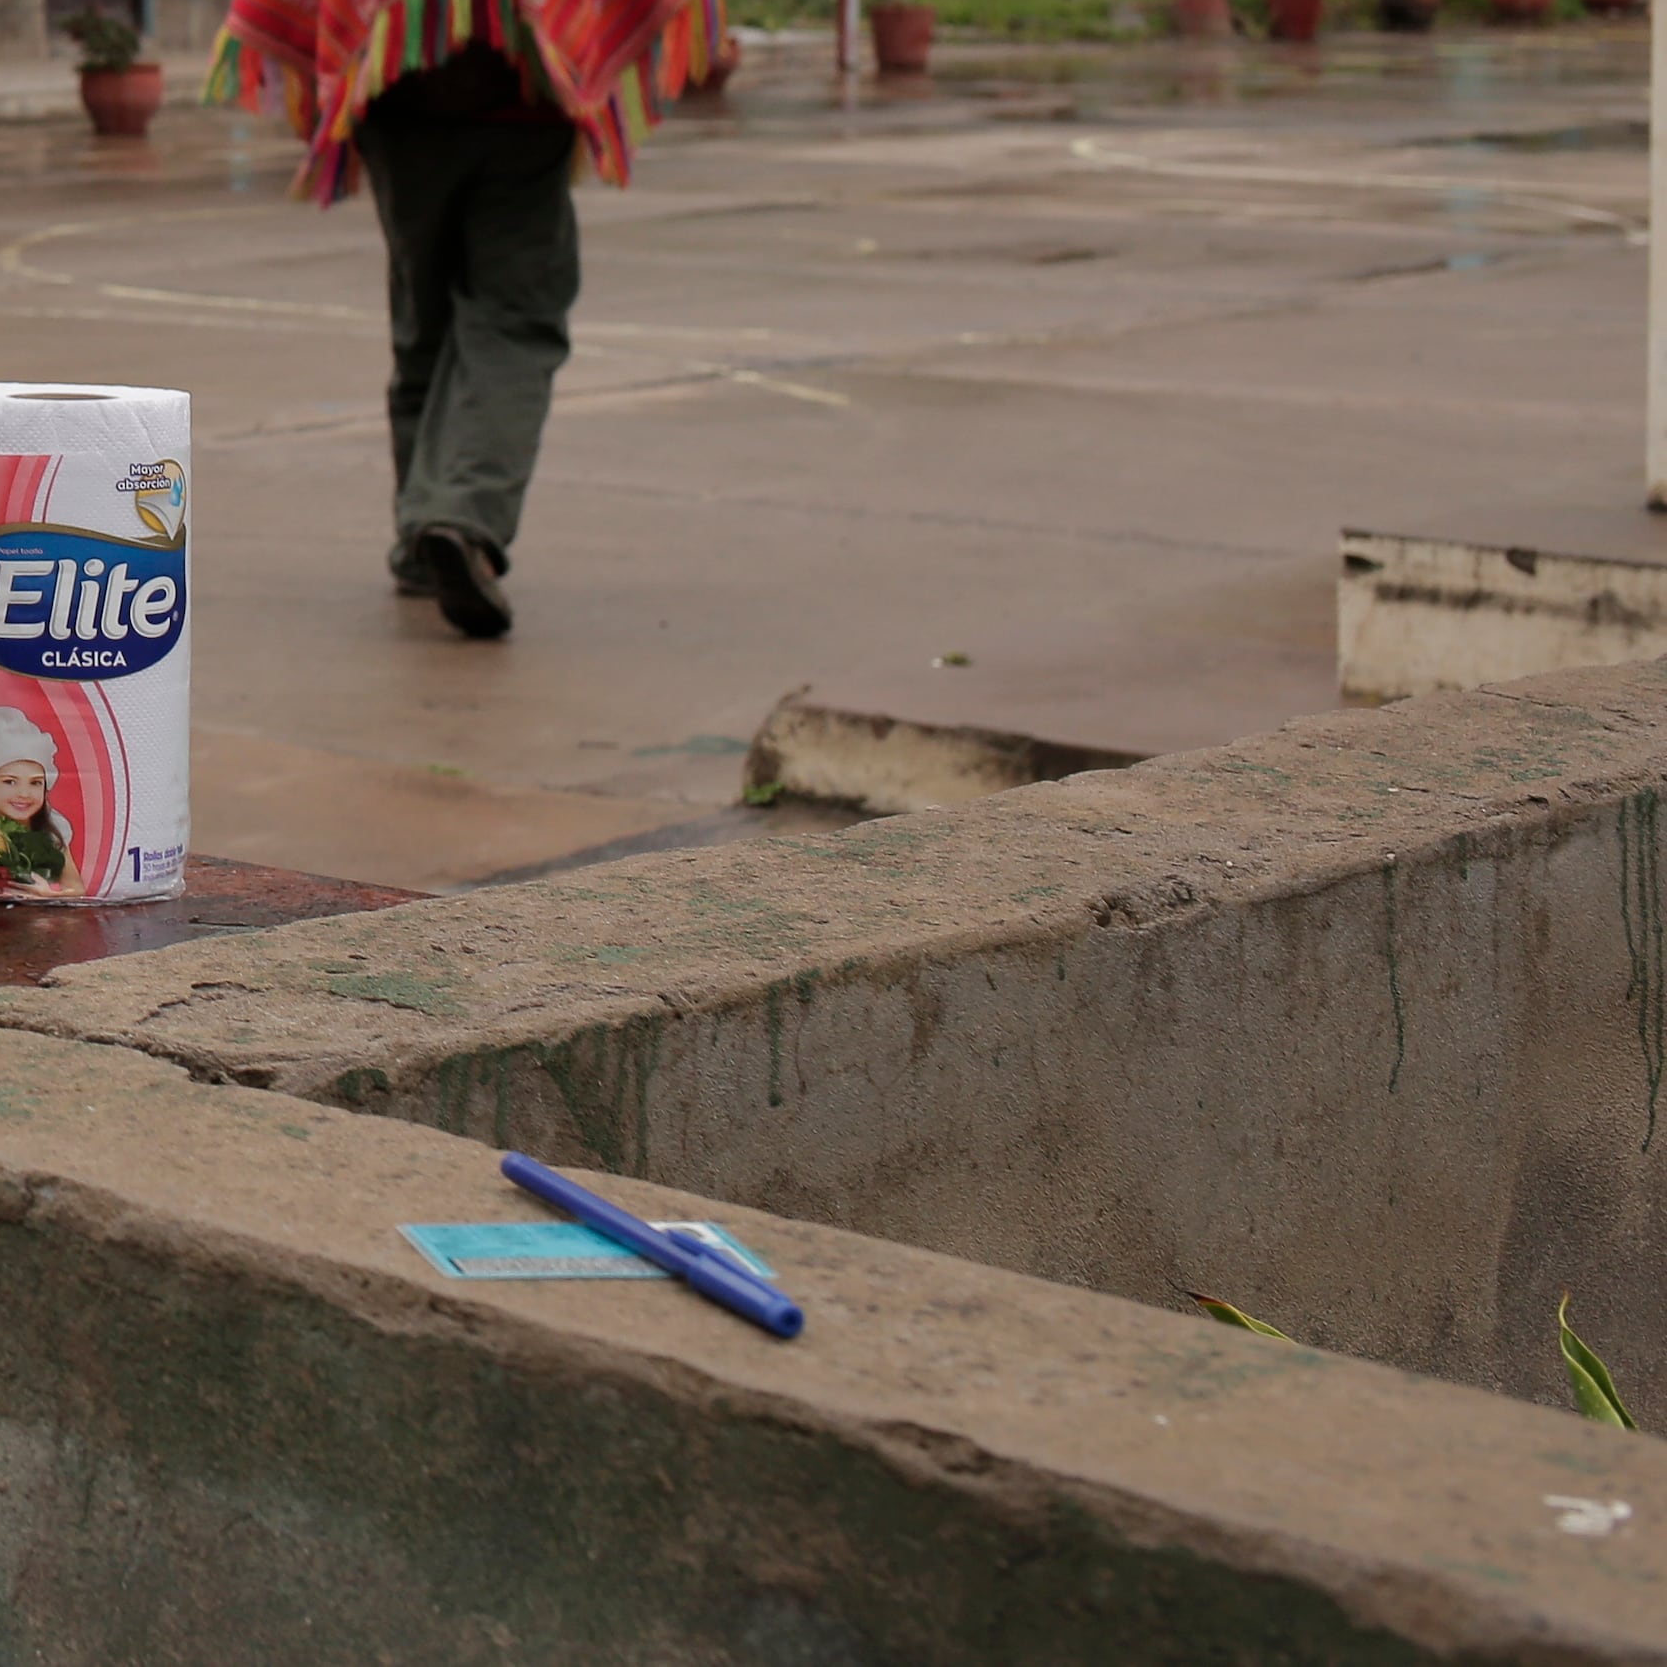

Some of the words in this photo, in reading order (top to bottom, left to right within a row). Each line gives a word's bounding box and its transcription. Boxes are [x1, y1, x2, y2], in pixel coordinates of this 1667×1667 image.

[130, 464, 164, 476] Mayor
[116, 476, 172, 492] absorción
[41, 646, 127, 667] CLÁSICA
[128, 846, 141, 882] 1
